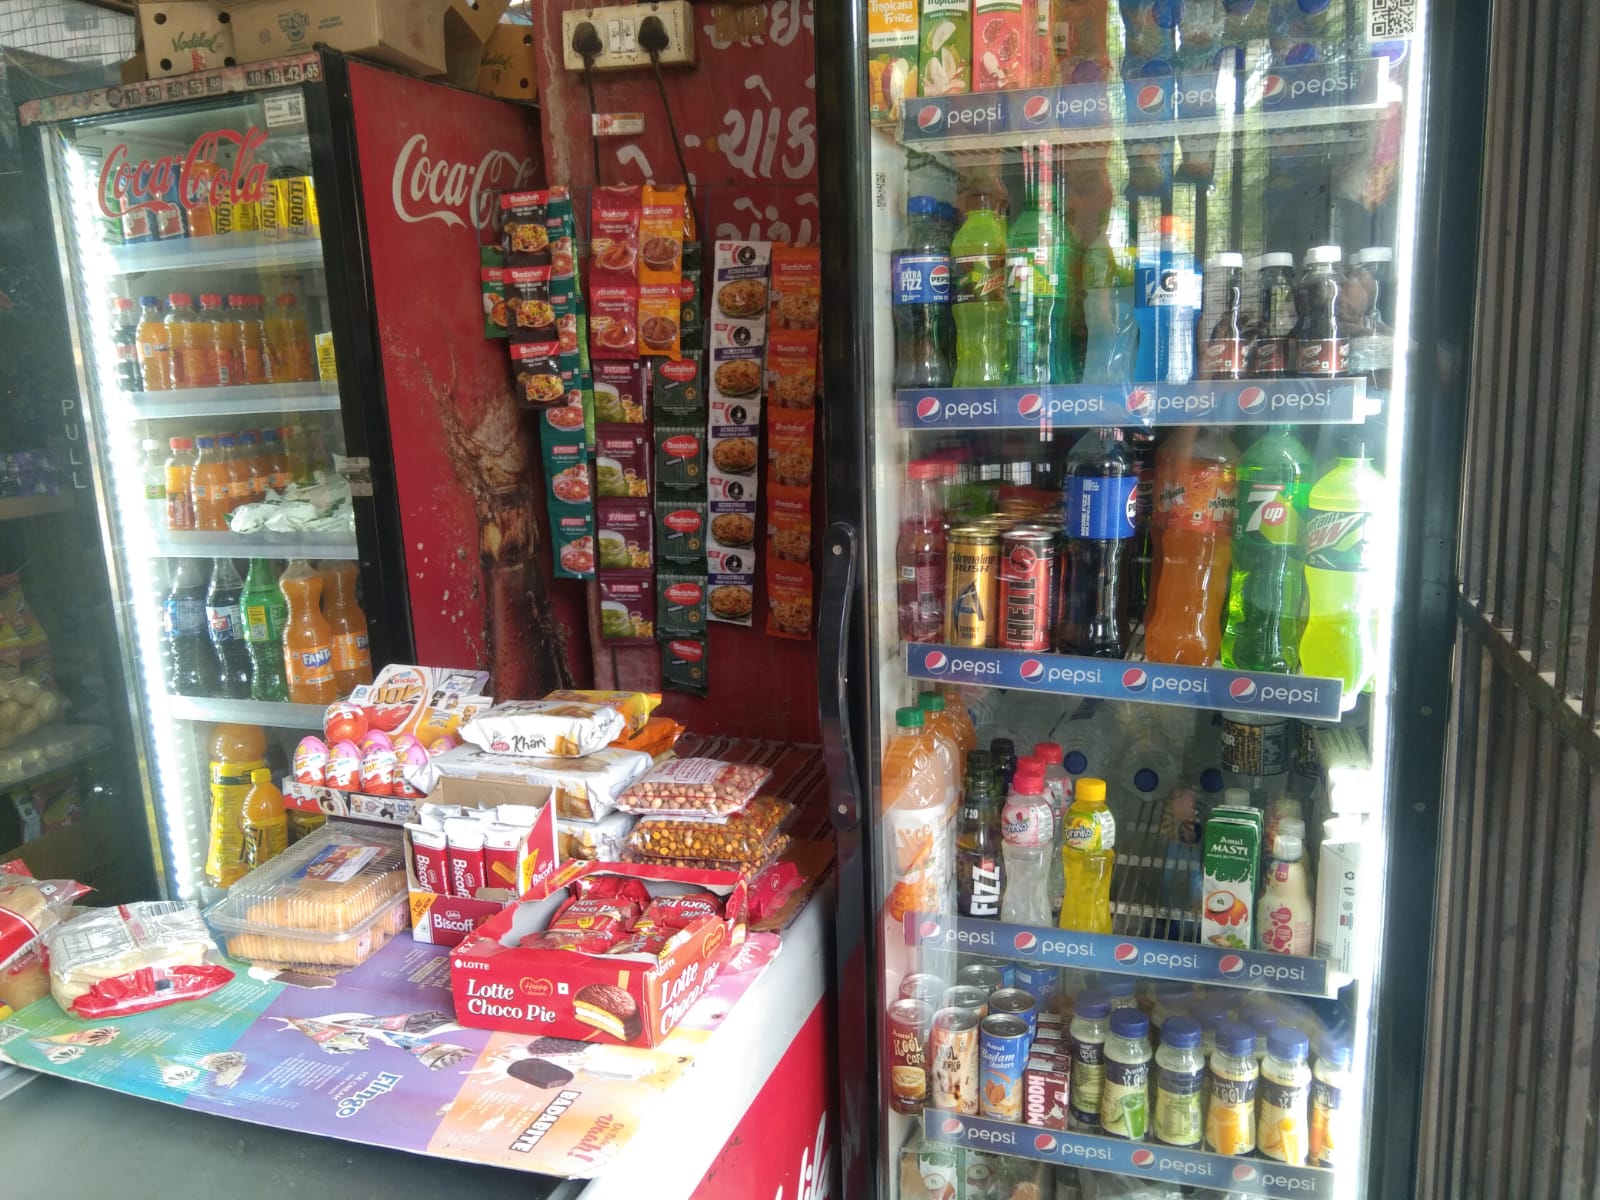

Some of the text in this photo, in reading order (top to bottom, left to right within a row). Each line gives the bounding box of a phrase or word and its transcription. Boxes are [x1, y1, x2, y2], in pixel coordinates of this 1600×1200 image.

[947, 103, 1003, 129] pepsi
[1290, 76, 1354, 103] pepsi
[901, 279, 922, 291] FIZZ
[944, 390, 1331, 420] pepsi pepsi pepsi pepsi
[61, 399, 87, 489] PULL
[1246, 491, 1277, 532] 7
[950, 549, 995, 565] Adrenaline
[955, 564, 990, 573] RUSH
[1007, 576, 1037, 642] HELL
[385, 676, 419, 687] Kinder
[950, 657, 1319, 705] pepsi pepsi pepsi pepsi
[373, 686, 424, 705] JOY
[511, 734, 546, 753] Khari
[397, 802, 409, 814] DC
[1064, 827, 1093, 841] Drinko
[1220, 836, 1243, 846] Amul
[1211, 844, 1249, 857] MASTI
[971, 865, 1001, 916] FIZZ
[433, 913, 474, 932] Biscoff
[946, 926, 1307, 983] pepsi pepsi pepsi pepsi
[463, 961, 489, 971] LOTTE
[466, 978, 514, 999] Lotte
[659, 961, 699, 1010] Lotte
[699, 960, 721, 997] Pie
[468, 998, 556, 1023] Choco Pie
[893, 1037, 923, 1057] KOOL
[982, 1047, 1015, 1062] Badam
[986, 1041, 1005, 1052] Amul
[906, 1053, 926, 1066] Cafe
[335, 1071, 404, 1120] Flingo
[509, 1090, 582, 1154] BADABITE
[967, 1126, 1316, 1192] pepsi pepsi pepsi pepsi
